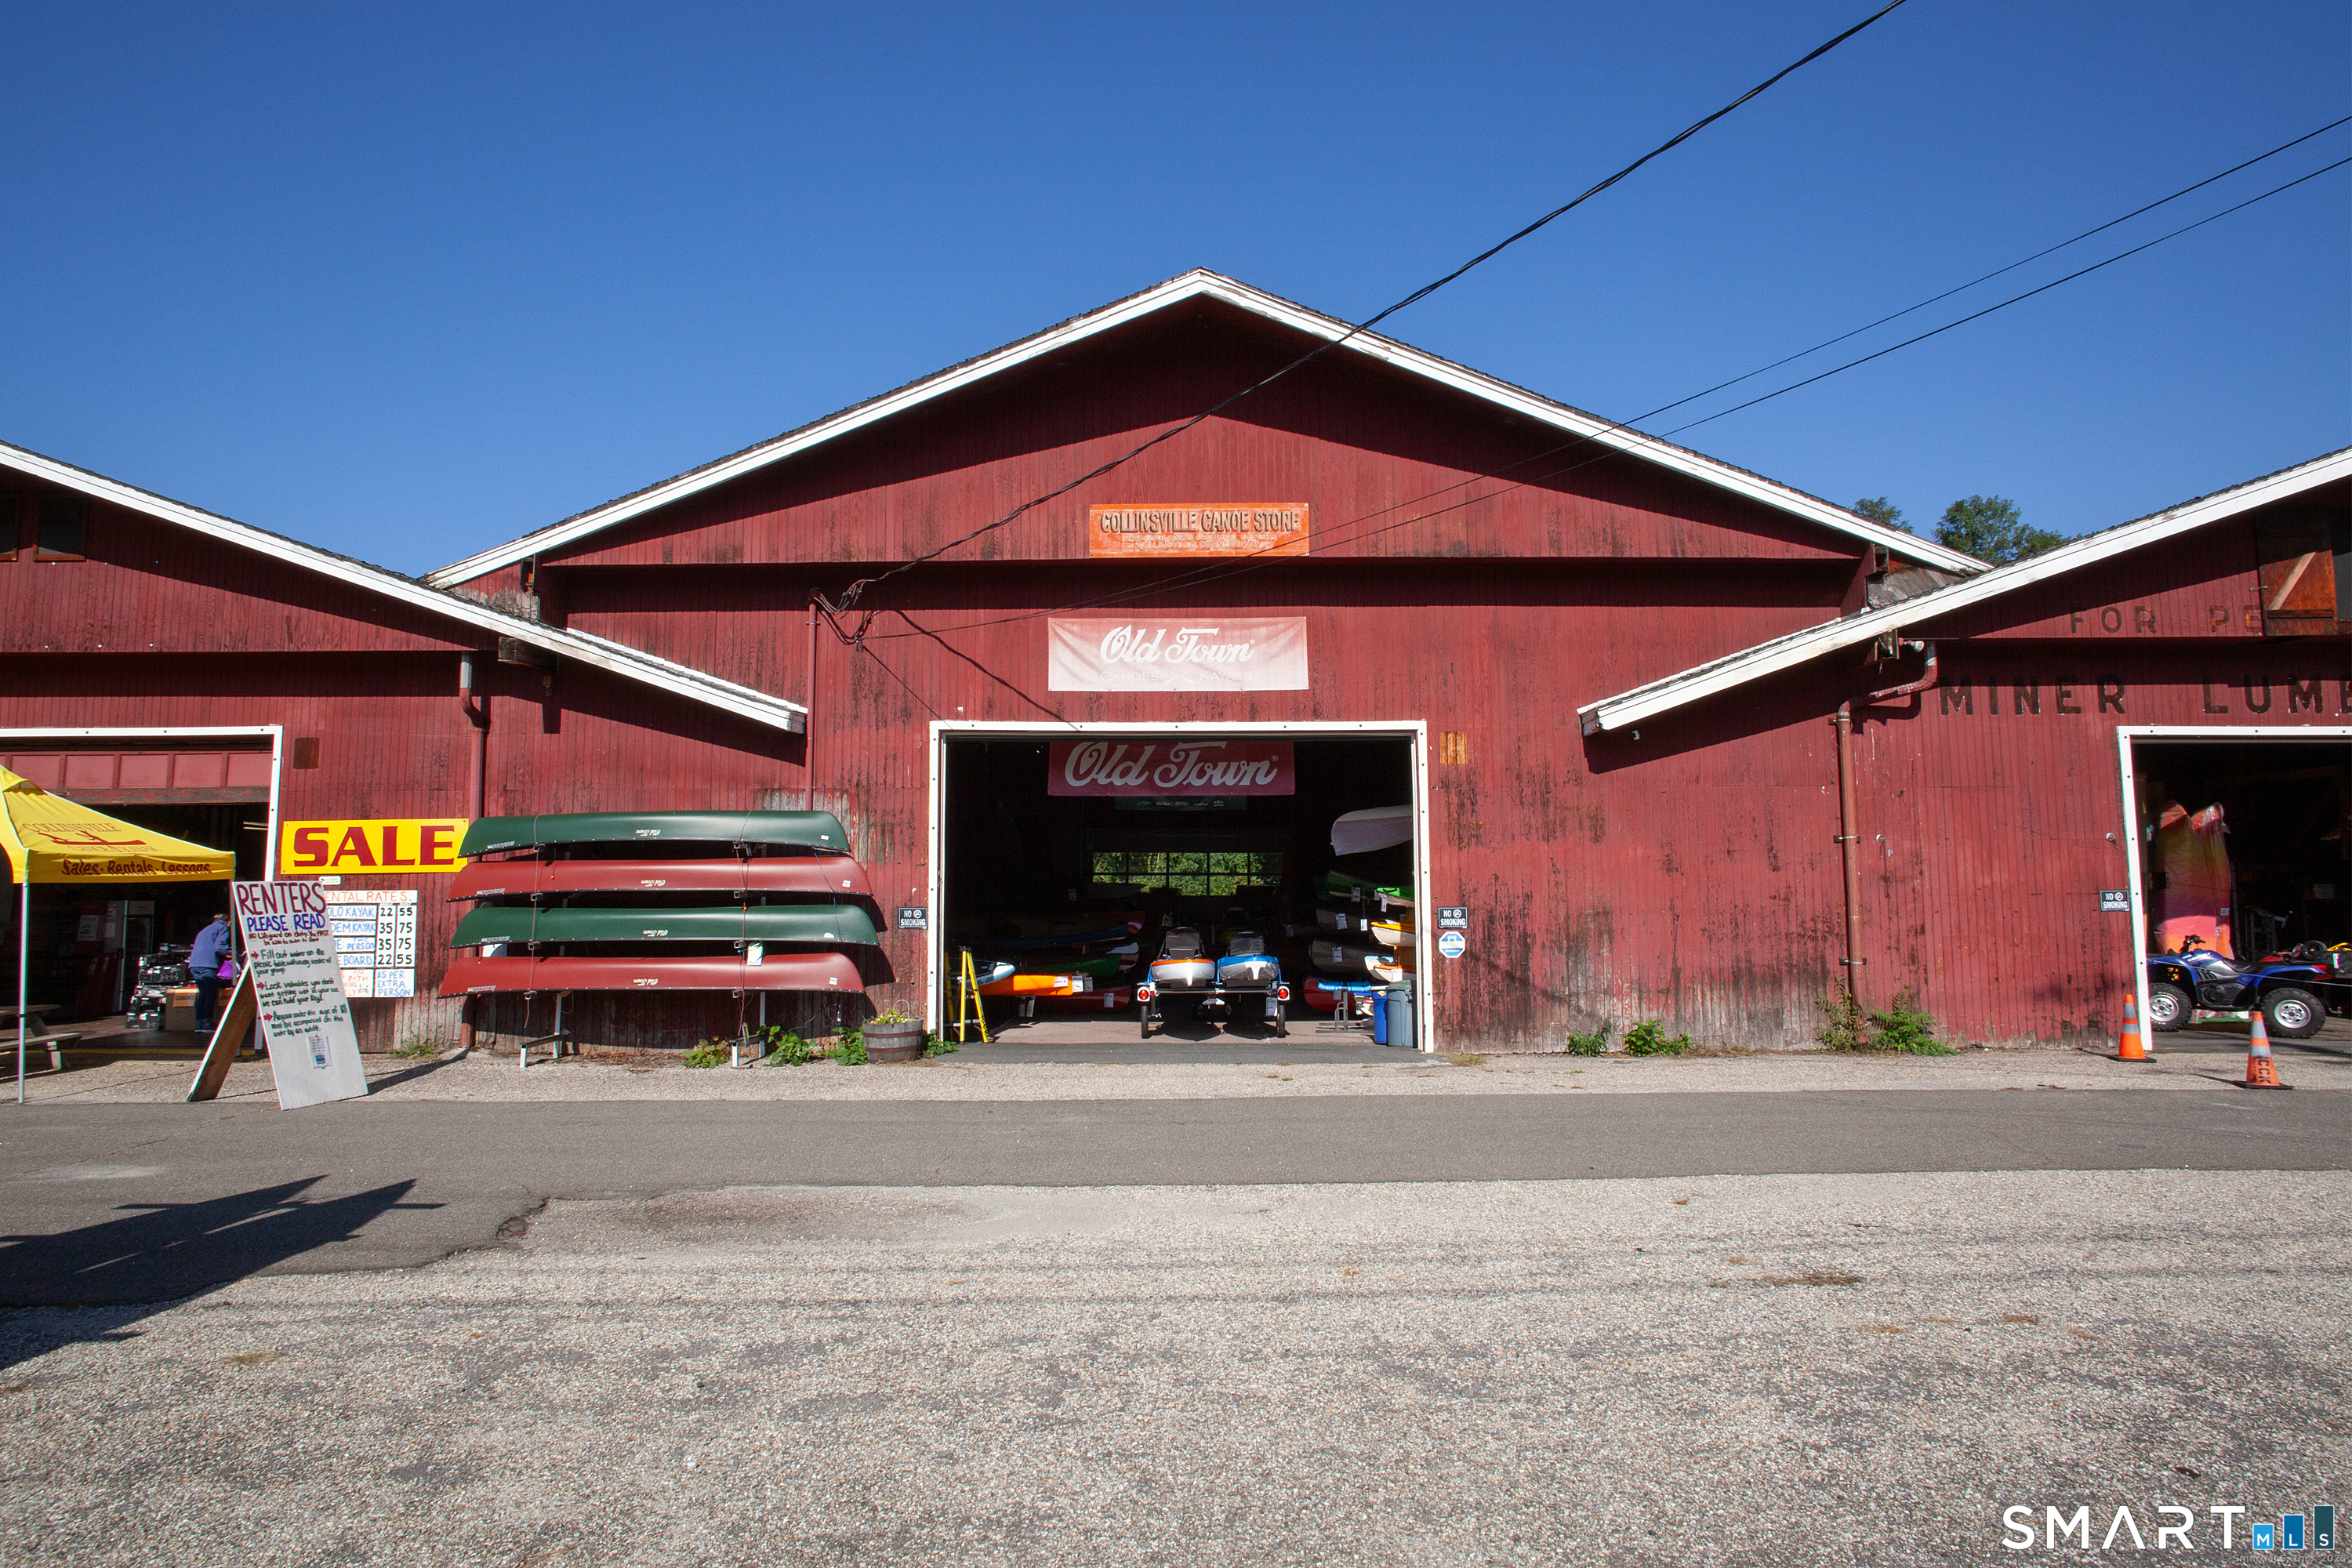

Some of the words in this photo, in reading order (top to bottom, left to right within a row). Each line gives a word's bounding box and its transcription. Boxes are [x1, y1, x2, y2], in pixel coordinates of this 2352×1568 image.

[1100, 510, 1197, 533] COLLINSVILLE
[1201, 510, 1250, 533] CANOE
[1253, 510, 1301, 533] STORE
[2070, 605, 2157, 634] FOR
[1100, 624, 1167, 664] Old
[1101, 671, 1160, 681] CANOES
[1200, 670, 1253, 681] KAYAKS
[1940, 674, 2126, 716] MINER
[1065, 742, 1157, 786] Old
[293, 825, 455, 867] SALE
[62, 858, 100, 876] Sales
[107, 860, 157, 876] Rentals
[162, 862, 212, 876] Lessons
[236, 882, 327, 916] RENTERS
[325, 891, 364, 902] ENTAL
[327, 906, 343, 916] OLO
[346, 906, 374, 917] KAYAK
[380, 907, 393, 916] 22
[399, 907, 413, 916] 55
[246, 914, 289, 931] PLEASE
[293, 913, 325, 930] READ
[352, 922, 376, 933] KAYAK
[379, 922, 393, 934] 35
[399, 922, 413, 933] 75
[378, 938, 392, 950] 35
[398, 938, 412, 949] 75
[260, 949, 275, 960] Fill
[275, 949, 288, 959] out
[343, 955, 372, 966] BOARD
[377, 954, 392, 964] 22
[397, 954, 412, 964] 55
[378, 989, 411, 997] PERSON
